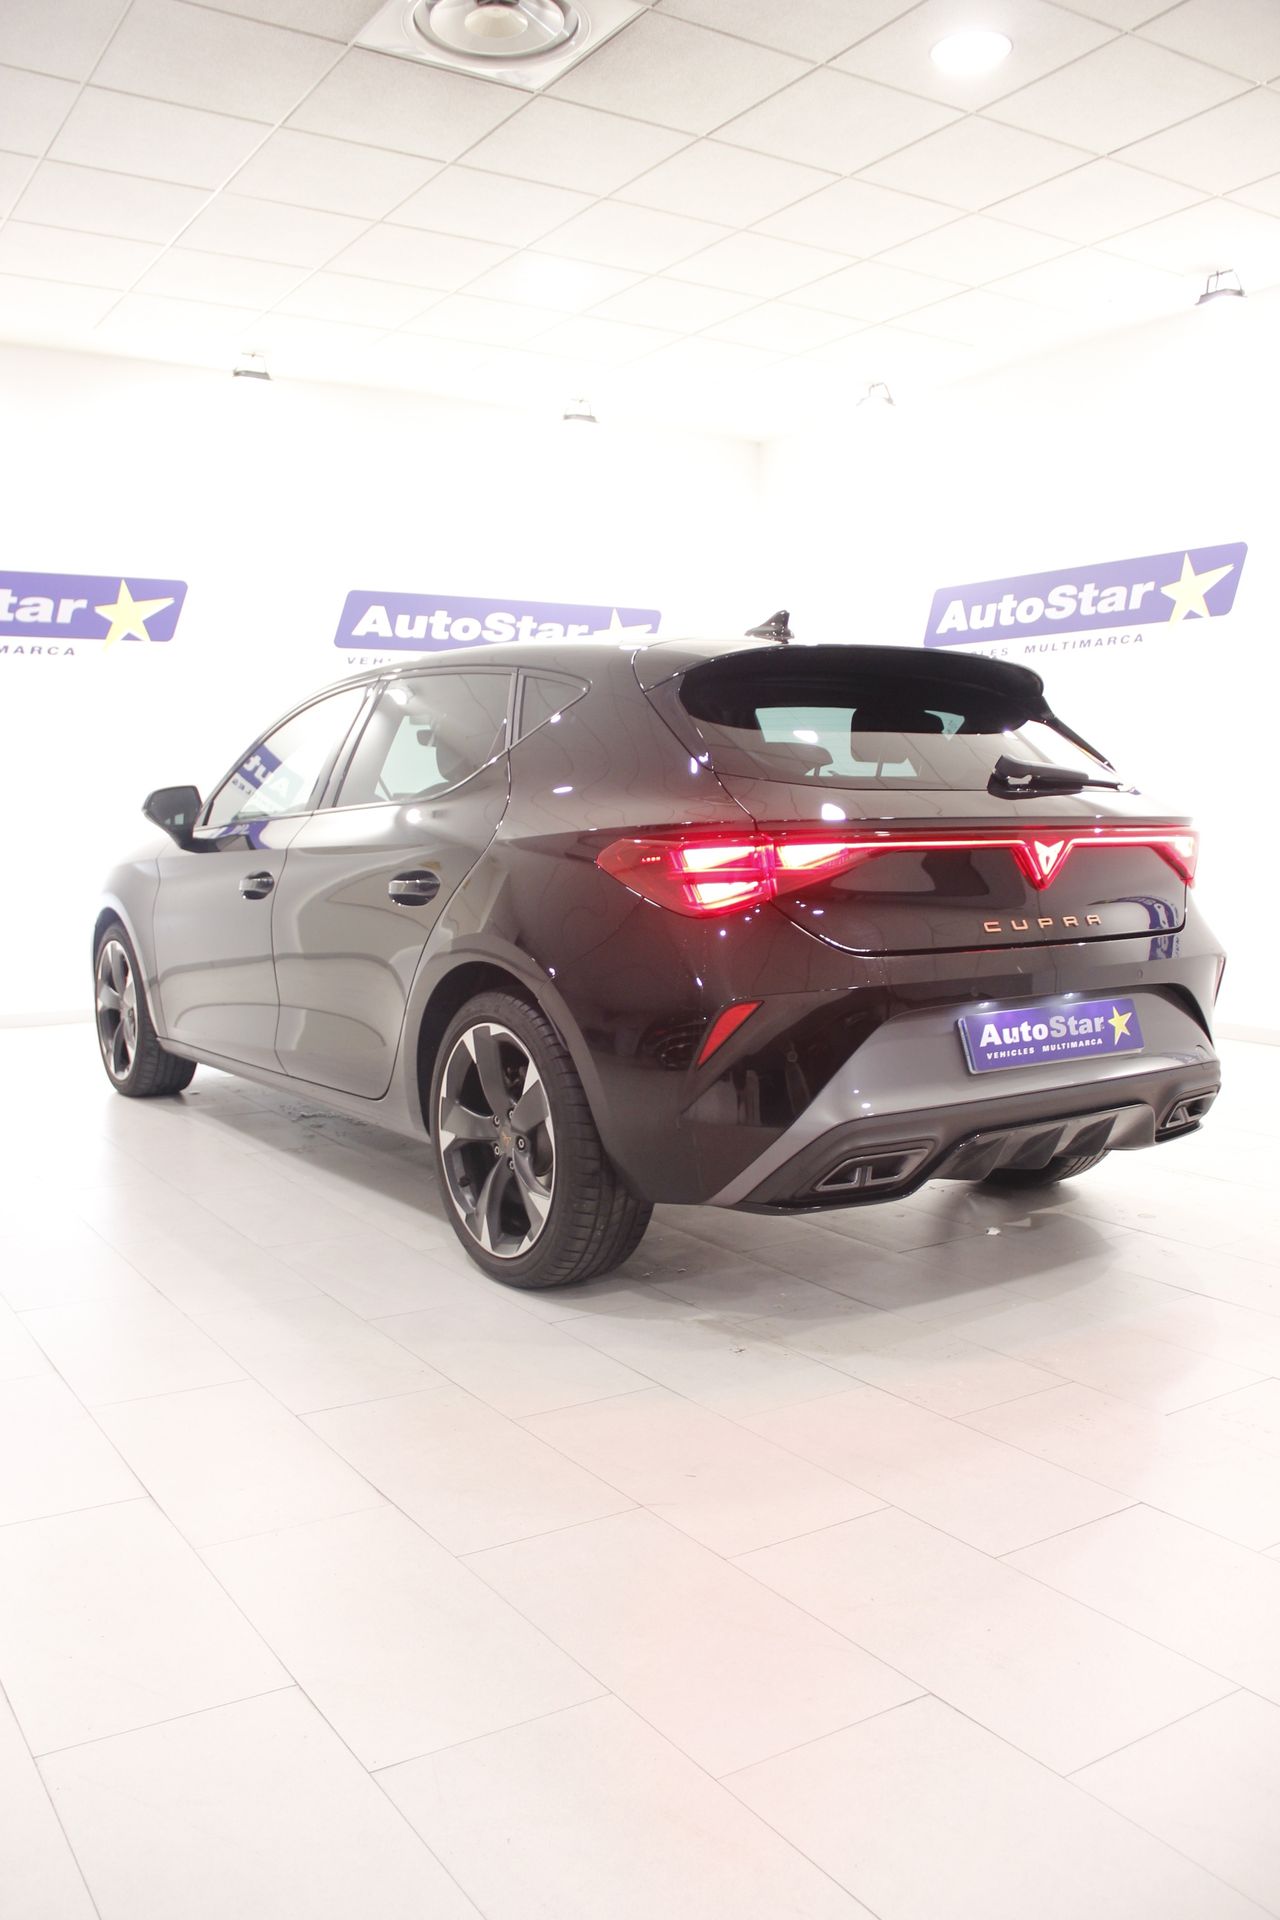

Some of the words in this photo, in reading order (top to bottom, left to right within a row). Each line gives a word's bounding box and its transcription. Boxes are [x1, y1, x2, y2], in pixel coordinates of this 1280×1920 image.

[0, 588, 88, 624] tar
[936, 581, 1155, 634] AutoStar
[352, 605, 589, 643] AutoStar
[1024, 633, 1144, 654] MULTIMARCA
[984, 914, 1102, 933] CUPRA
[979, 1015, 1104, 1047] AutoStar
[986, 1046, 1035, 1060] VEHICLES
[1042, 1038, 1103, 1053] MULTIMARCA
